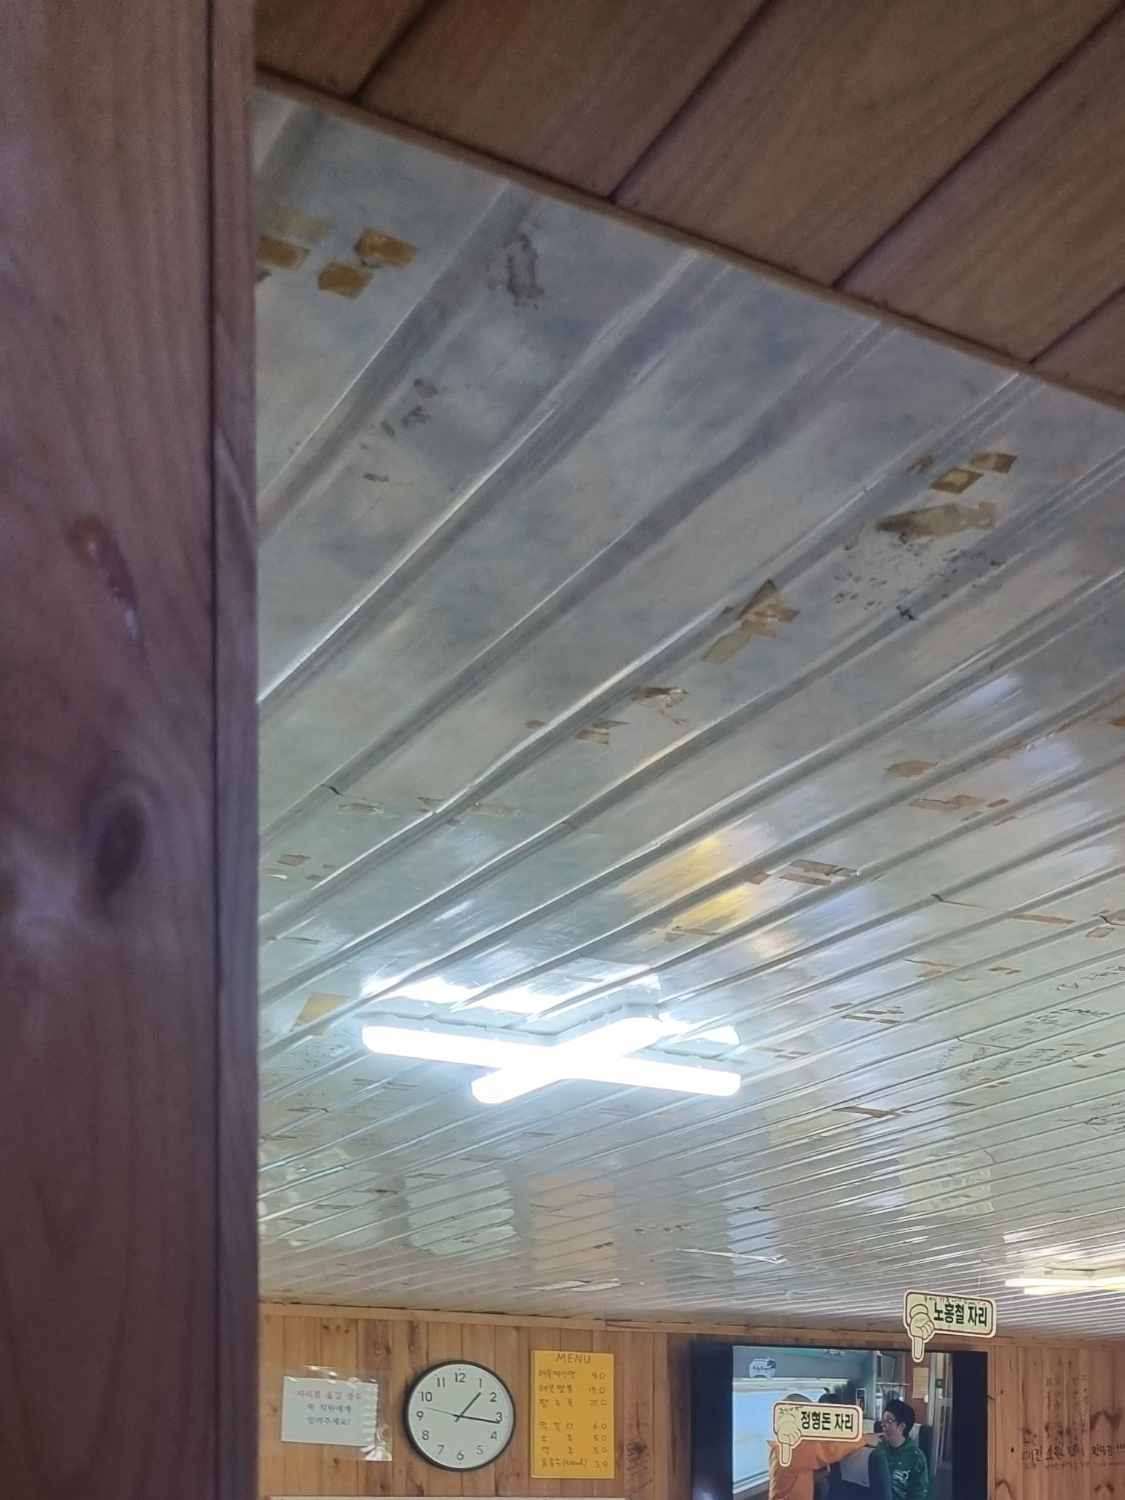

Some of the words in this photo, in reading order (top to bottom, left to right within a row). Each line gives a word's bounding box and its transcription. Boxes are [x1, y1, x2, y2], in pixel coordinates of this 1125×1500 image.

[933, 1302, 965, 1325] 노홍철
[967, 1305, 988, 1327] 자리
[556, 1353, 591, 1364] MENU
[437, 1378, 446, 1388] 11
[455, 1373, 466, 1384] 12
[298, 1389, 321, 1400] 자리를
[420, 1392, 432, 1402] 10
[489, 1392, 497, 1402] 2
[320, 1403, 351, 1413] 직원에게
[416, 1411, 424, 1421] 9
[496, 1411, 503, 1423] 3
[801, 1411, 831, 1431] 정형돈
[834, 1413, 853, 1432] 자리
[422, 1430, 430, 1440] 8
[489, 1431, 497, 1441] 4
[437, 1445, 445, 1455] 7
[476, 1445, 484, 1455] 5
[456, 1450, 464, 1461] 6
